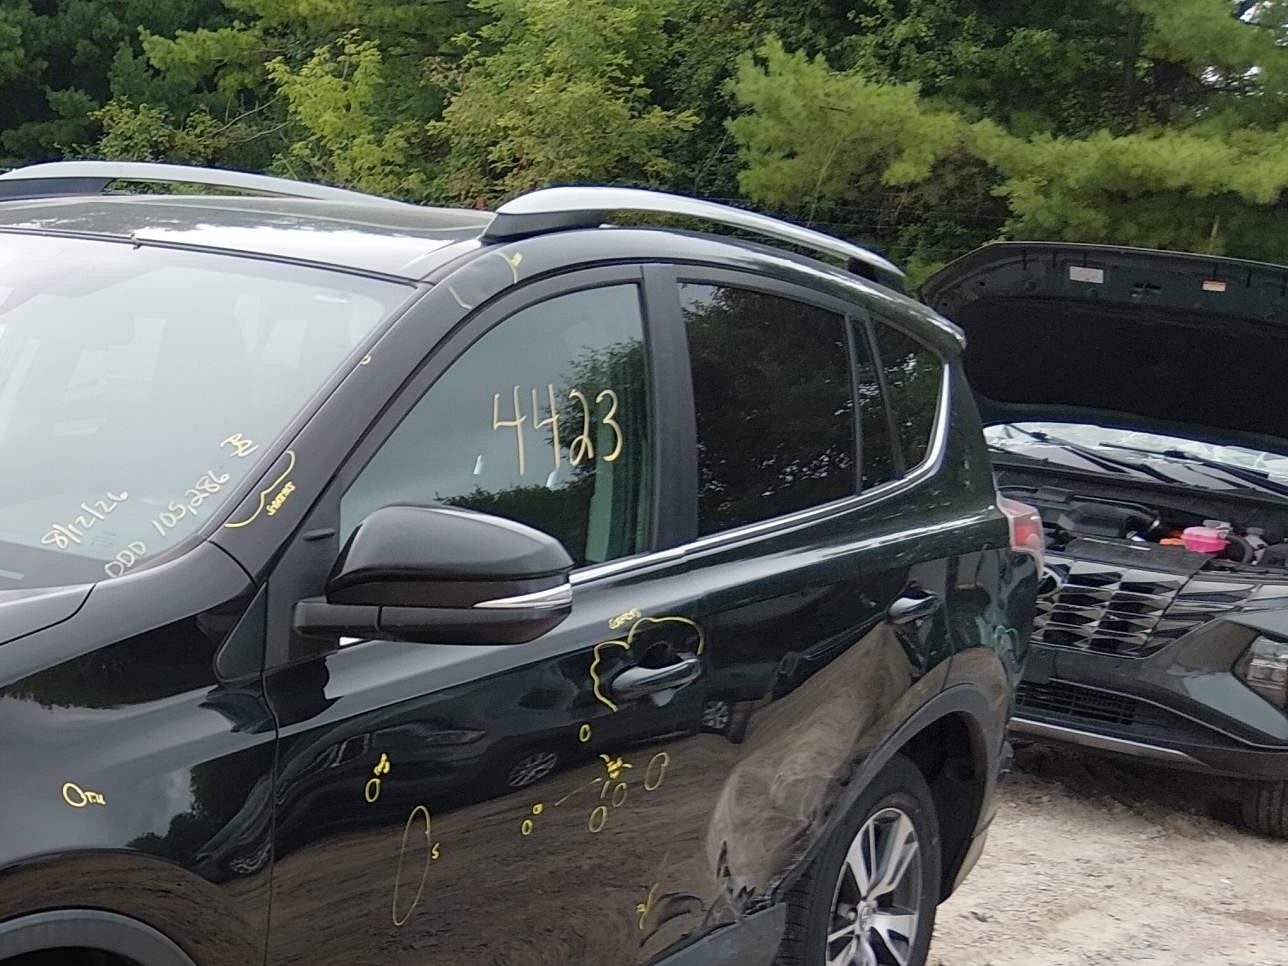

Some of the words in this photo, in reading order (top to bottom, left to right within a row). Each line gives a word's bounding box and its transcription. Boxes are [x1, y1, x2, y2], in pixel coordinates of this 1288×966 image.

[492, 383, 623, 477] 4423
[40, 491, 129, 549] 8/12/26
[151, 469, 230, 537] 105,286
